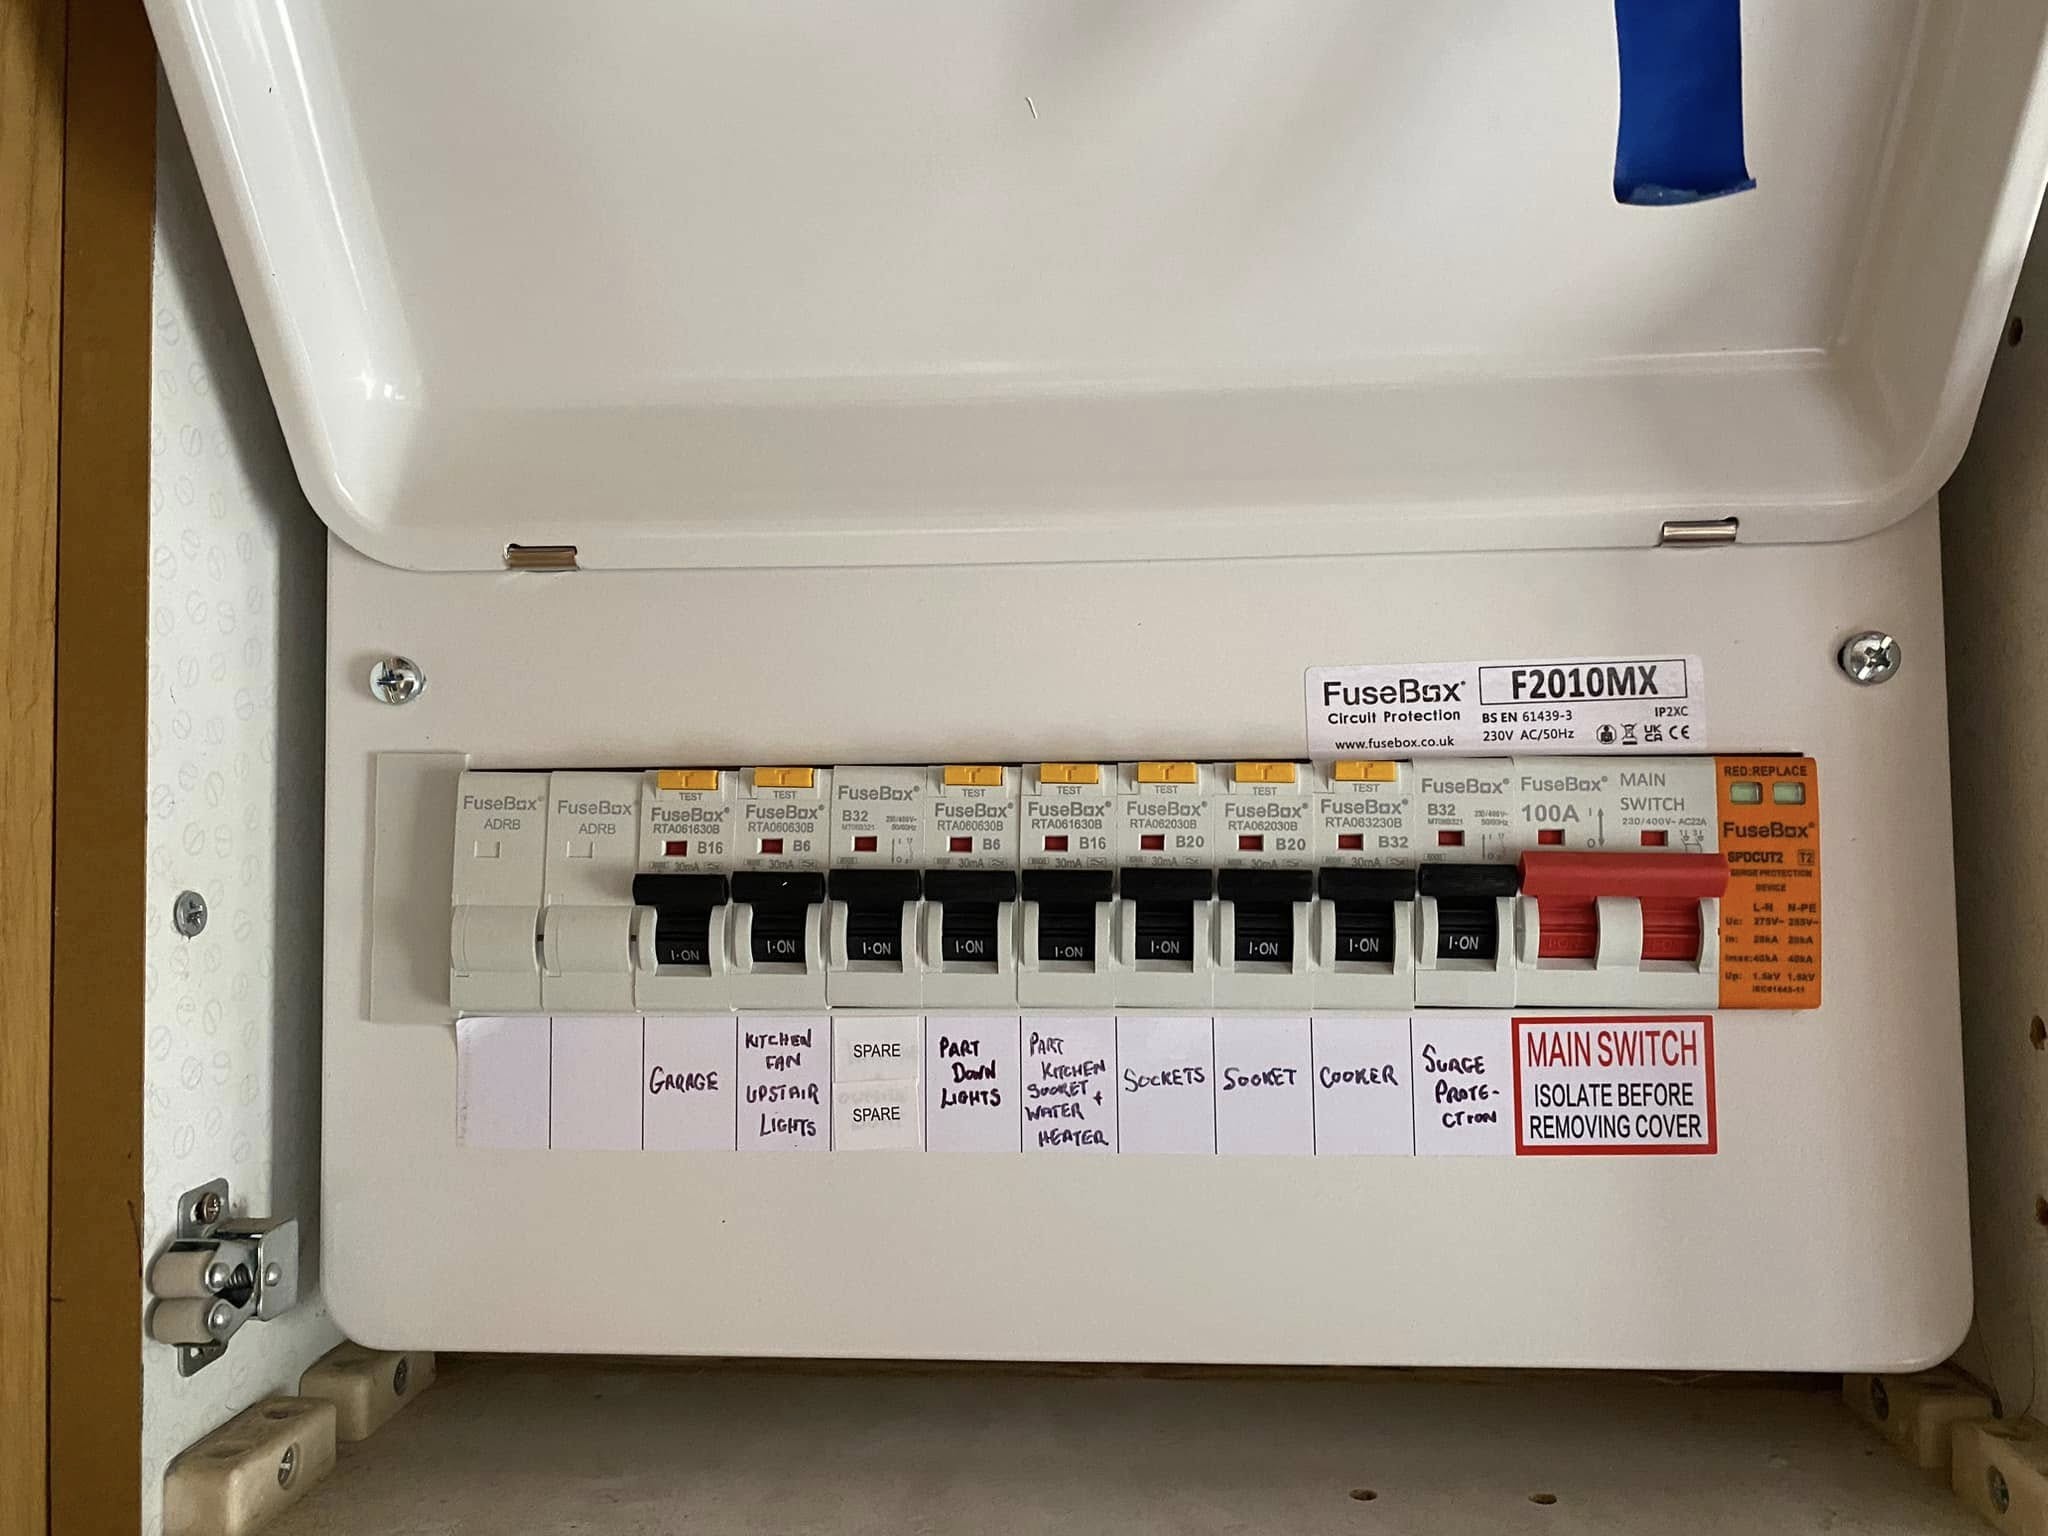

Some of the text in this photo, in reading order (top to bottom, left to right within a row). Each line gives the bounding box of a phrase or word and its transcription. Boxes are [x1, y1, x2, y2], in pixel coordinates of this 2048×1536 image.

[1511, 664, 1659, 700] F2010MX
[1323, 678, 1466, 706] FuseBox
[1328, 709, 1461, 724] Circuit Protection
[1482, 709, 1573, 723] BS EN 61439-3
[1654, 705, 1689, 717] IP2XC
[1483, 727, 1575, 741] 230V AC/50Hz
[1335, 736, 1455, 750] www.fusebox.co.uk
[1422, 778, 1503, 794] FuseBox
[1521, 776, 1601, 792] FuseBox
[1620, 773, 1665, 787] MAIN
[773, 790, 798, 799] TEST
[838, 786, 913, 801] FuseBox
[962, 789, 986, 797] TEST
[1057, 786, 1081, 795] TEST
[1155, 785, 1179, 794] TEST
[1253, 786, 1277, 796] TEST
[1353, 784, 1380, 793] TEST
[463, 795, 538, 810] FuseBox
[679, 792, 703, 801] TEST
[1620, 797, 1685, 811] SWITCH
[558, 801, 632, 815] FuseBox
[746, 805, 818, 820] FuseBox
[935, 803, 1008, 818] FuseBox
[1028, 802, 1105, 817] FuseBox
[1127, 801, 1202, 816] FuseBox
[1225, 803, 1302, 818] FuseBox
[1321, 798, 1402, 815] FuseBox
[1427, 803, 1456, 816] B32
[1522, 804, 1580, 823] 100A
[651, 807, 724, 822] FuseBox
[842, 810, 868, 822] B32
[484, 819, 521, 830] ADRB
[578, 824, 616, 835] ADRB
[1723, 822, 1808, 838] FuseBox
[698, 841, 724, 854] B16
[793, 840, 811, 852] B6
[982, 839, 1001, 850] B6
[1079, 837, 1106, 849] B16
[1176, 835, 1204, 848] B20
[1276, 838, 1306, 851] B20
[1378, 836, 1408, 849] B32
[1788, 903, 1816, 913] N-PE
[745, 1029, 812, 1048] KITCHEN
[1029, 1032, 1064, 1056] PART
[853, 1043, 901, 1057] SPARE
[939, 1037, 980, 1058] PART
[1527, 1030, 1697, 1067] MAIN SWITCH
[766, 1053, 801, 1071] FAN
[1422, 1044, 1485, 1075] SURGE
[952, 1060, 996, 1083] DOWN
[1041, 1059, 1106, 1080] KITCHEN
[1320, 1065, 1399, 1089] COOKER
[650, 1066, 719, 1094] GARAGE
[1124, 1068, 1205, 1093] SOCKETS
[746, 1083, 819, 1104] UPSTAIR
[940, 1088, 1001, 1109] LIGHTS
[1534, 1083, 1694, 1107] ISOLATE BEFORE
[852, 1106, 900, 1122] SPARE
[1025, 1103, 1085, 1121] WATER
[1442, 1111, 1497, 1128] CTION
[760, 1113, 817, 1136] LIGHTS
[1530, 1114, 1702, 1139] REMOVING COVER
[1038, 1128, 1109, 1147] HEATER
